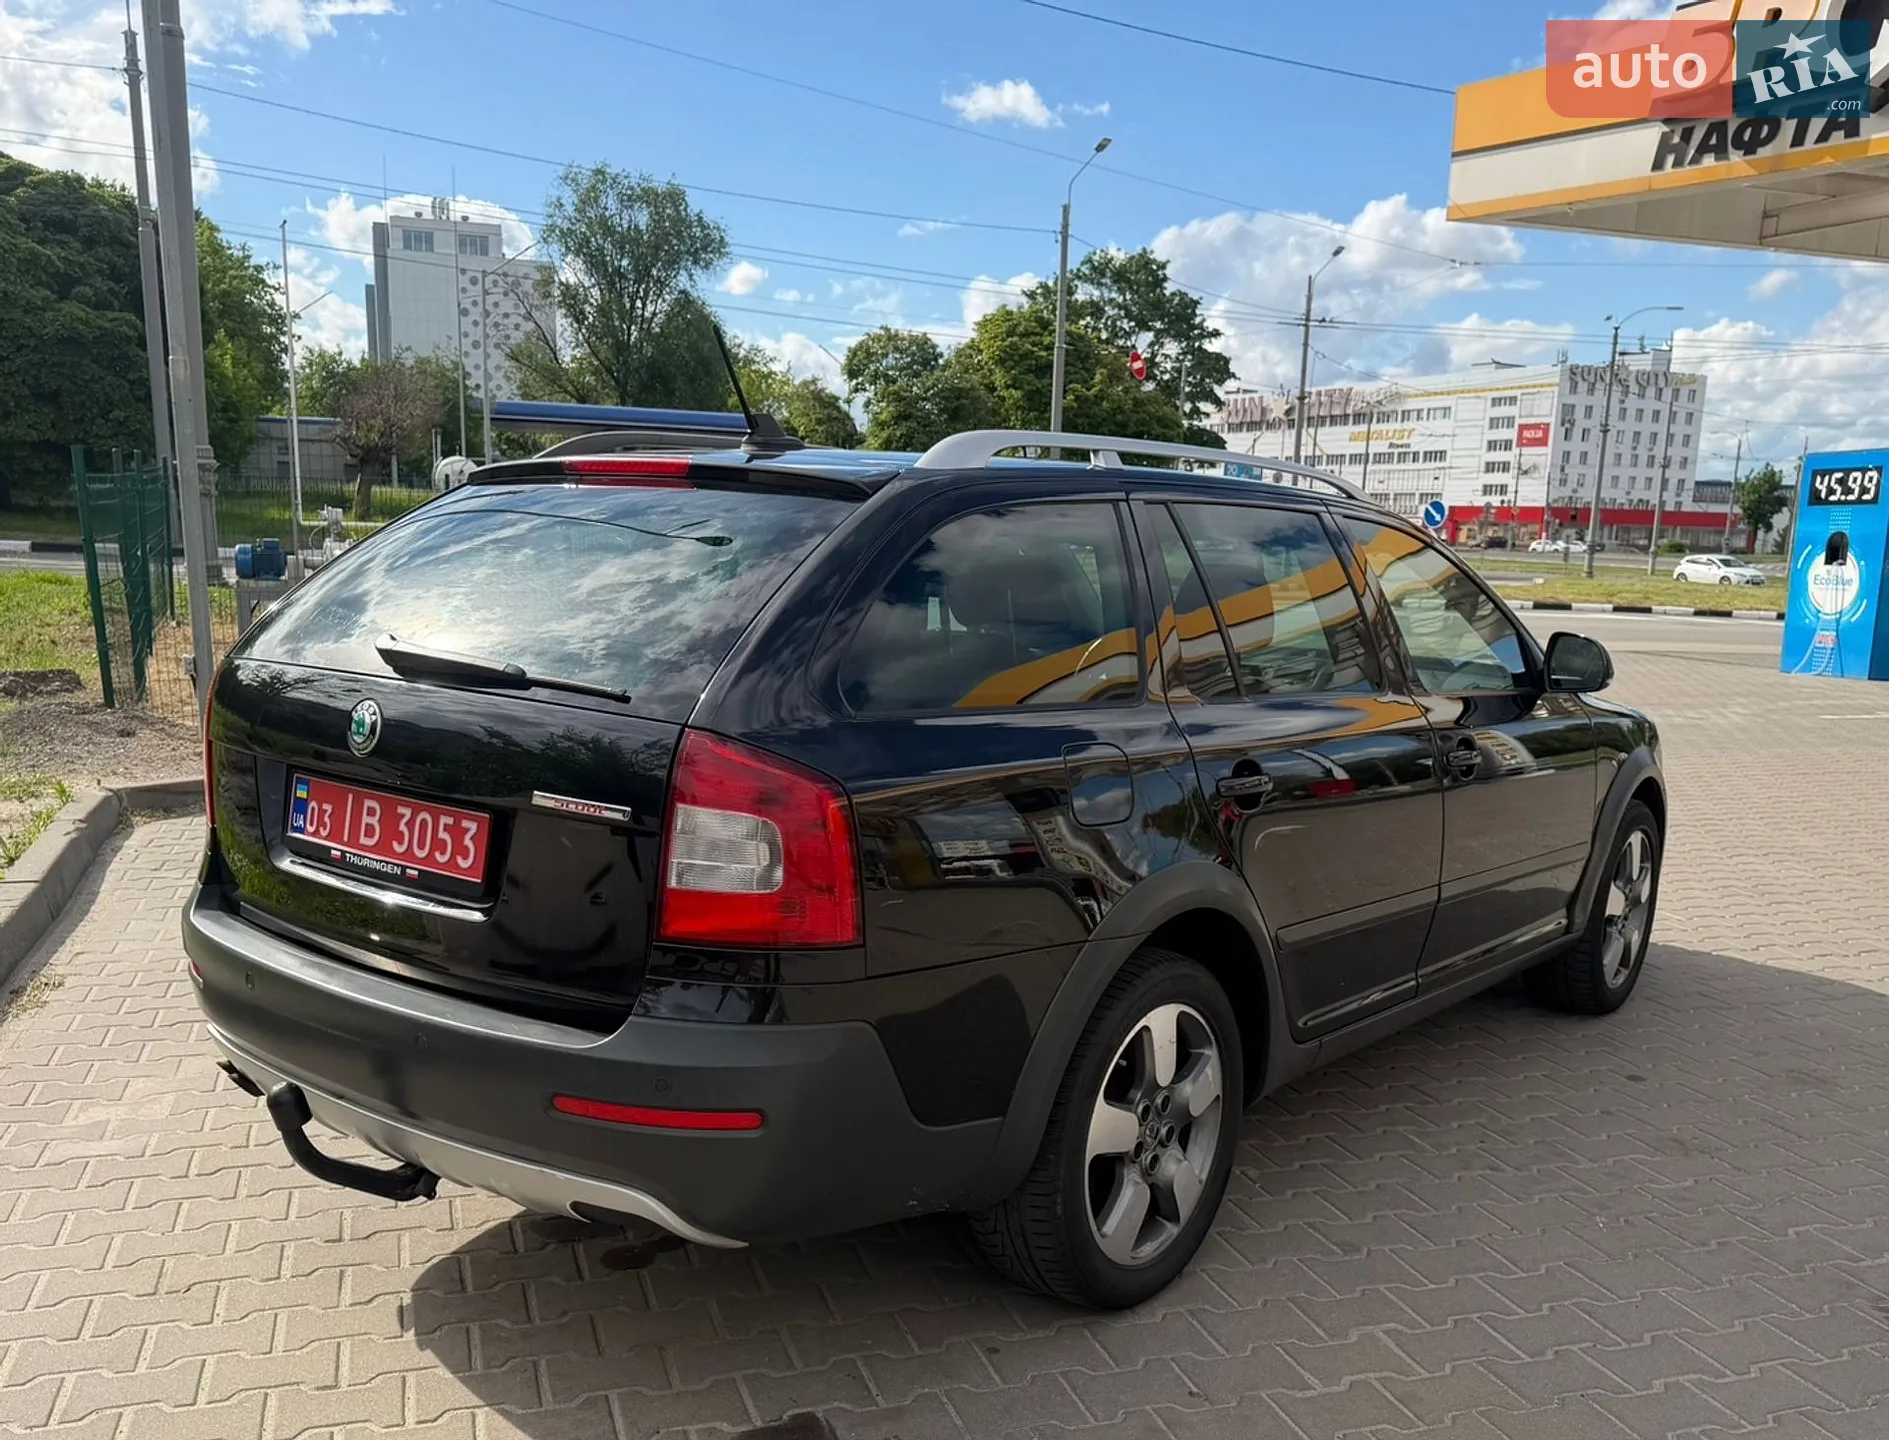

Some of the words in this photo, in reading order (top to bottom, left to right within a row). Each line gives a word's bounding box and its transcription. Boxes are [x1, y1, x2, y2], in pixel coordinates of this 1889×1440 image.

[1651, 96, 1861, 172] НАФТА
[1815, 470, 1877, 501] 45.99
[293, 812, 305, 829] UA
[306, 800, 333, 837] 03
[391, 805, 479, 869] 3053
